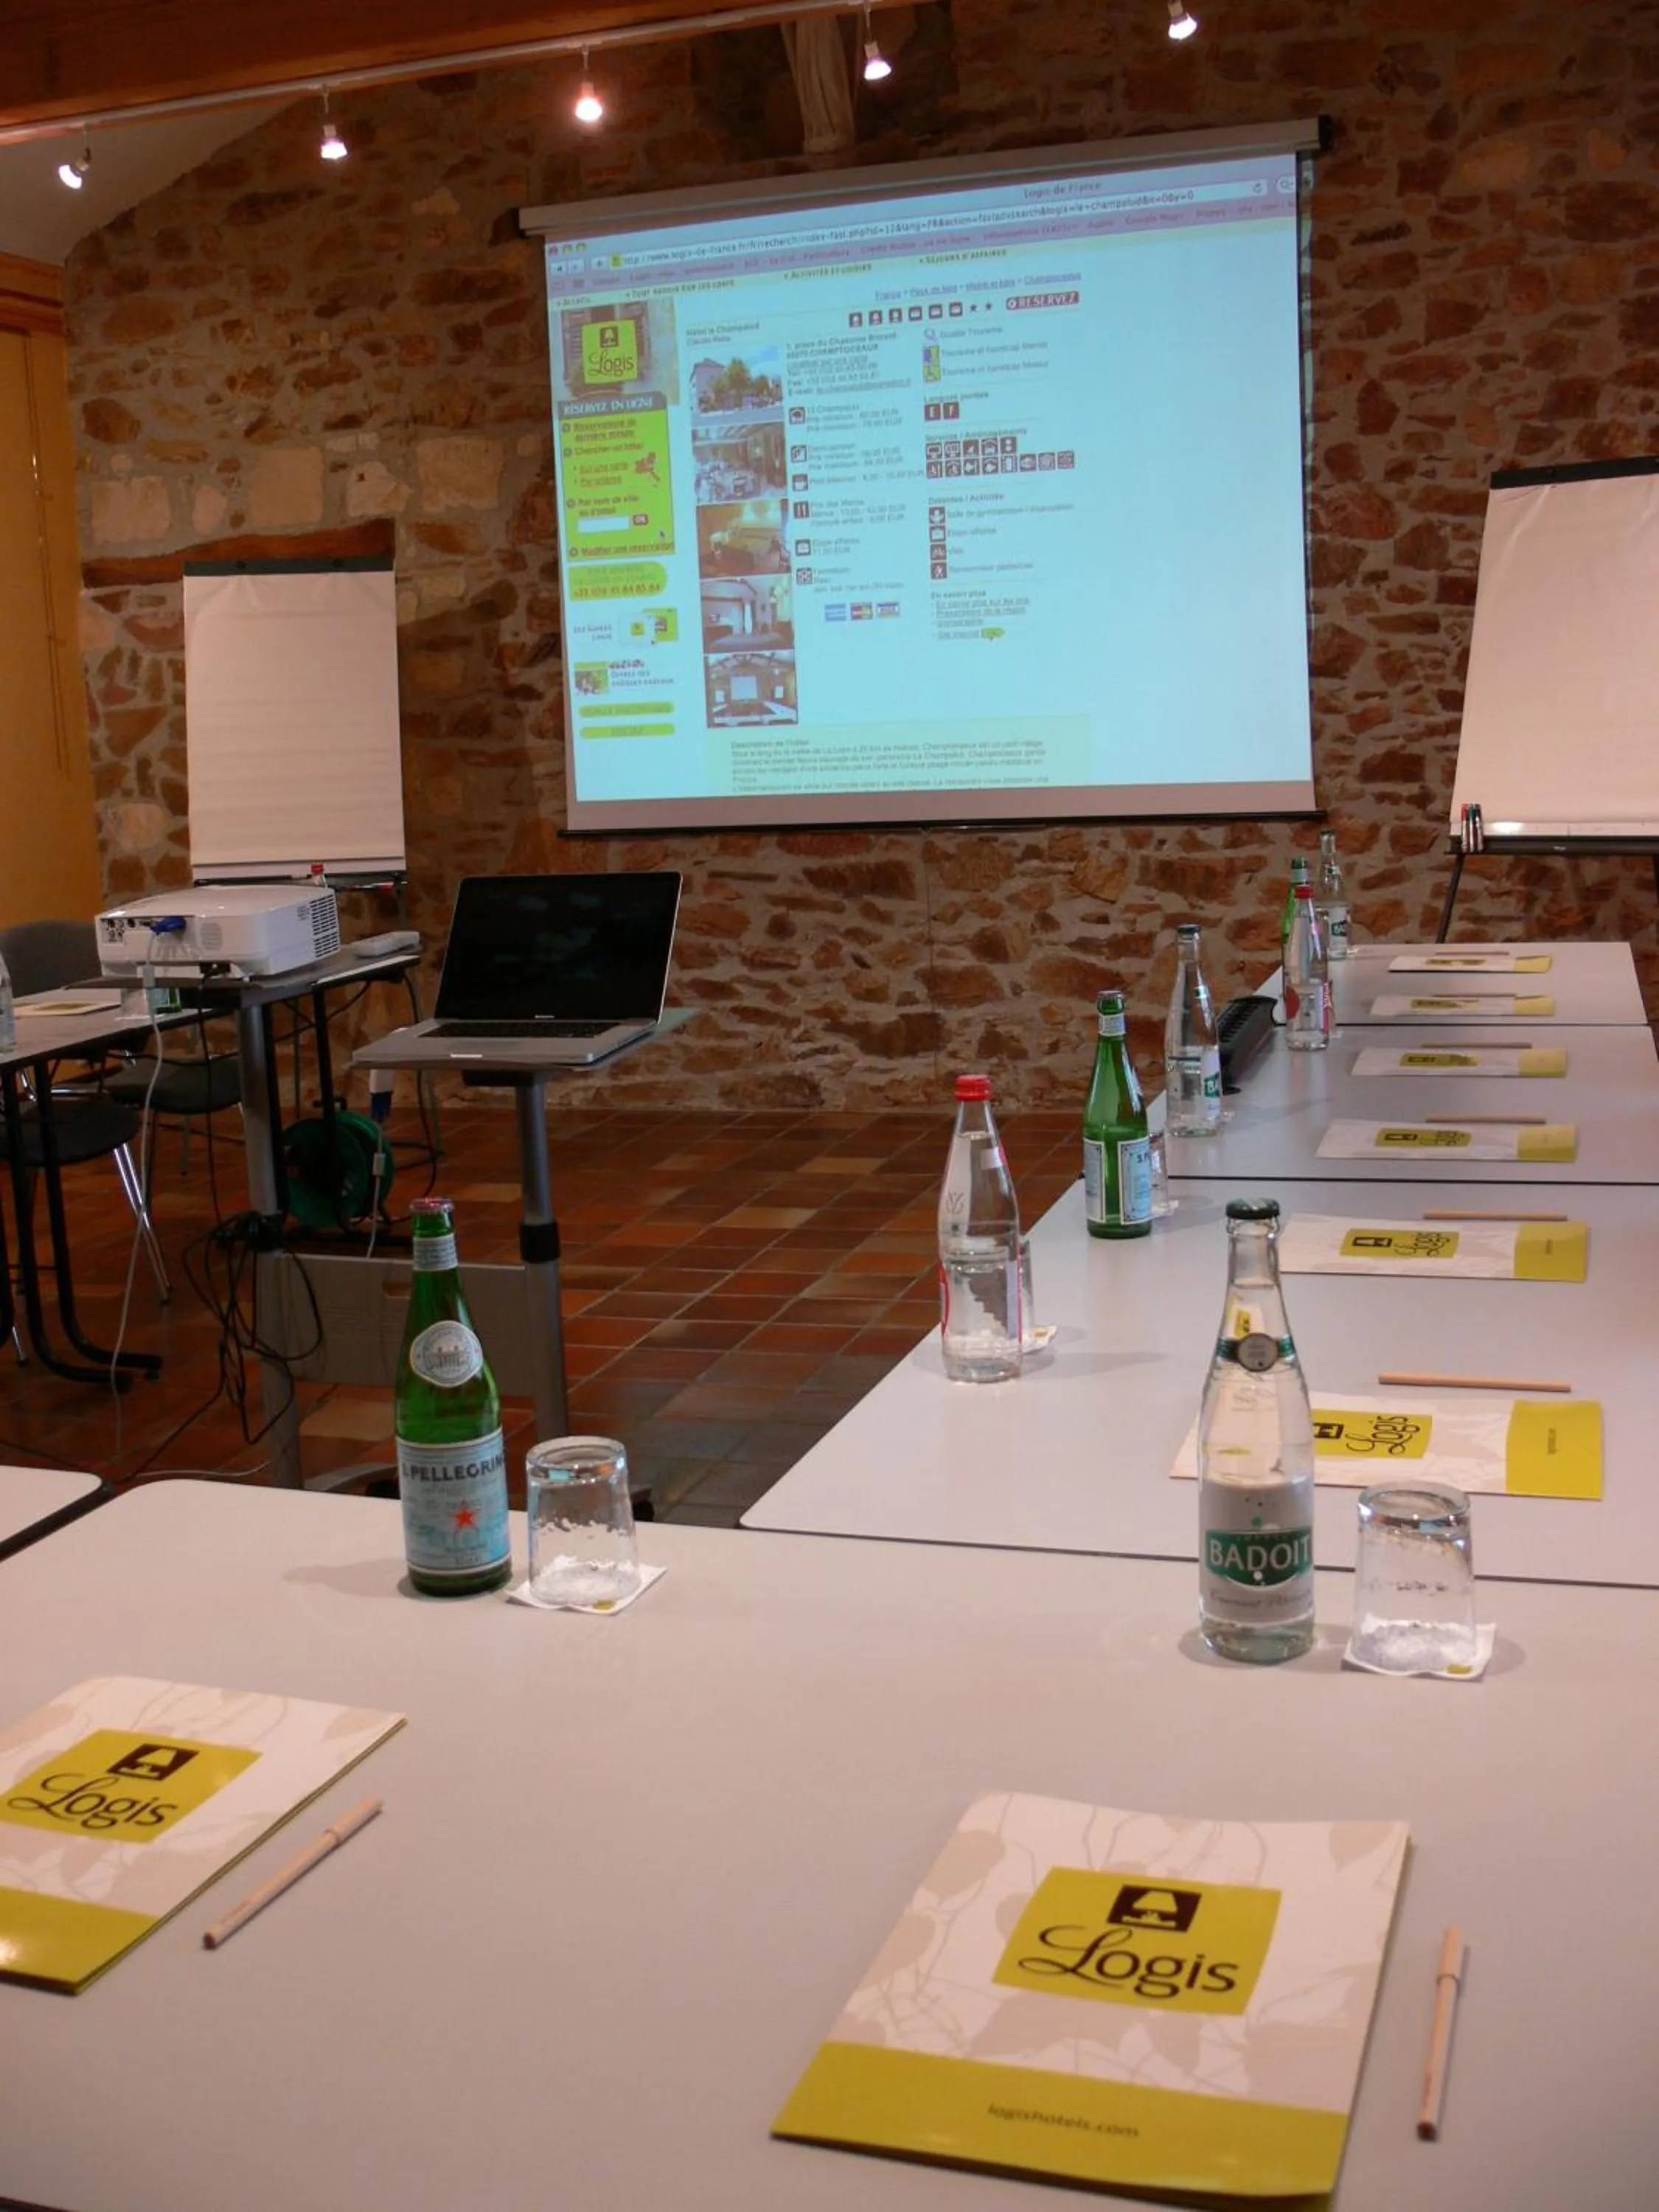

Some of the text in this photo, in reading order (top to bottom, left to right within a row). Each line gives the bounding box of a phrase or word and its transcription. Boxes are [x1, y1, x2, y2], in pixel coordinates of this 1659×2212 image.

[588, 349, 634, 377] Logis
[1345, 1415, 1421, 1455] Logis
[1208, 1534, 1310, 1572] BADOIT
[7, 1772, 178, 1830] Logis
[1017, 1923, 1240, 1999] Logis
[987, 2102, 1140, 2138] logishotels.com
